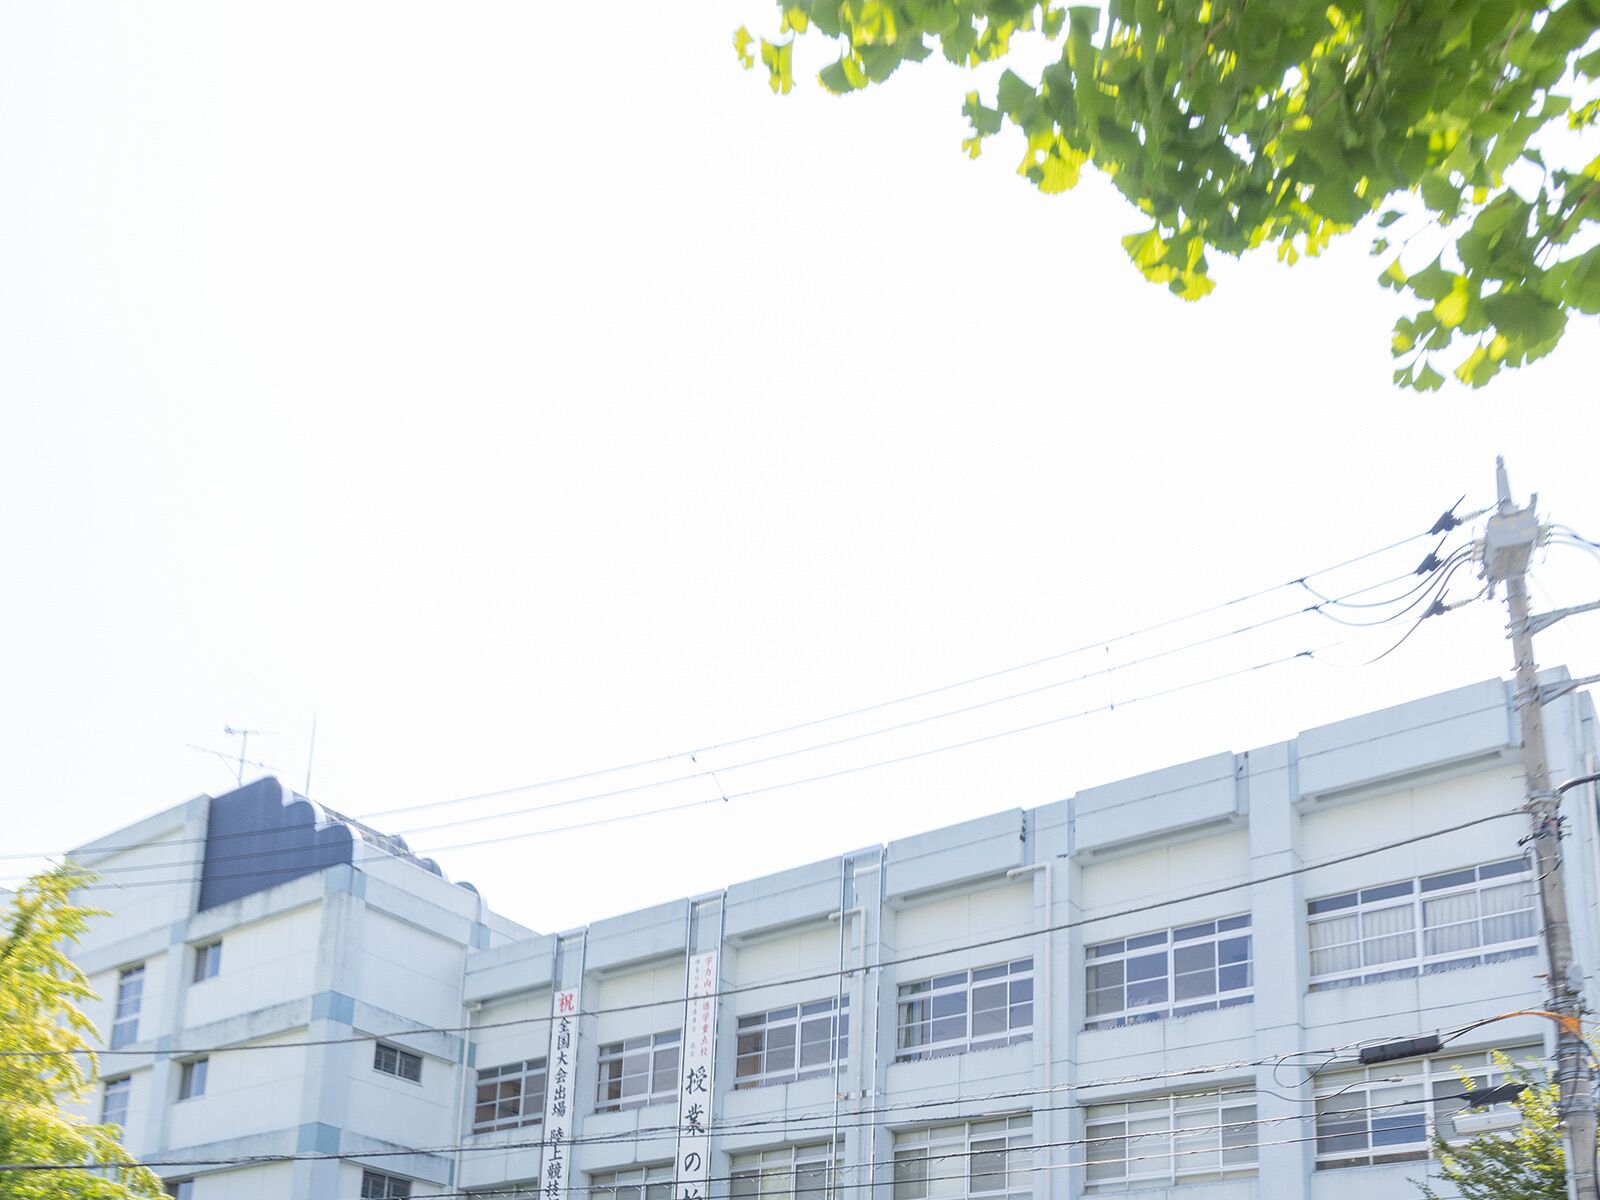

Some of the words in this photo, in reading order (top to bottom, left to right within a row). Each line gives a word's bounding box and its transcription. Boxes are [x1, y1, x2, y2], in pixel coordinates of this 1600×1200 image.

[558, 992, 574, 1013] 祝
[551, 1016, 571, 1118] 全国大会出場
